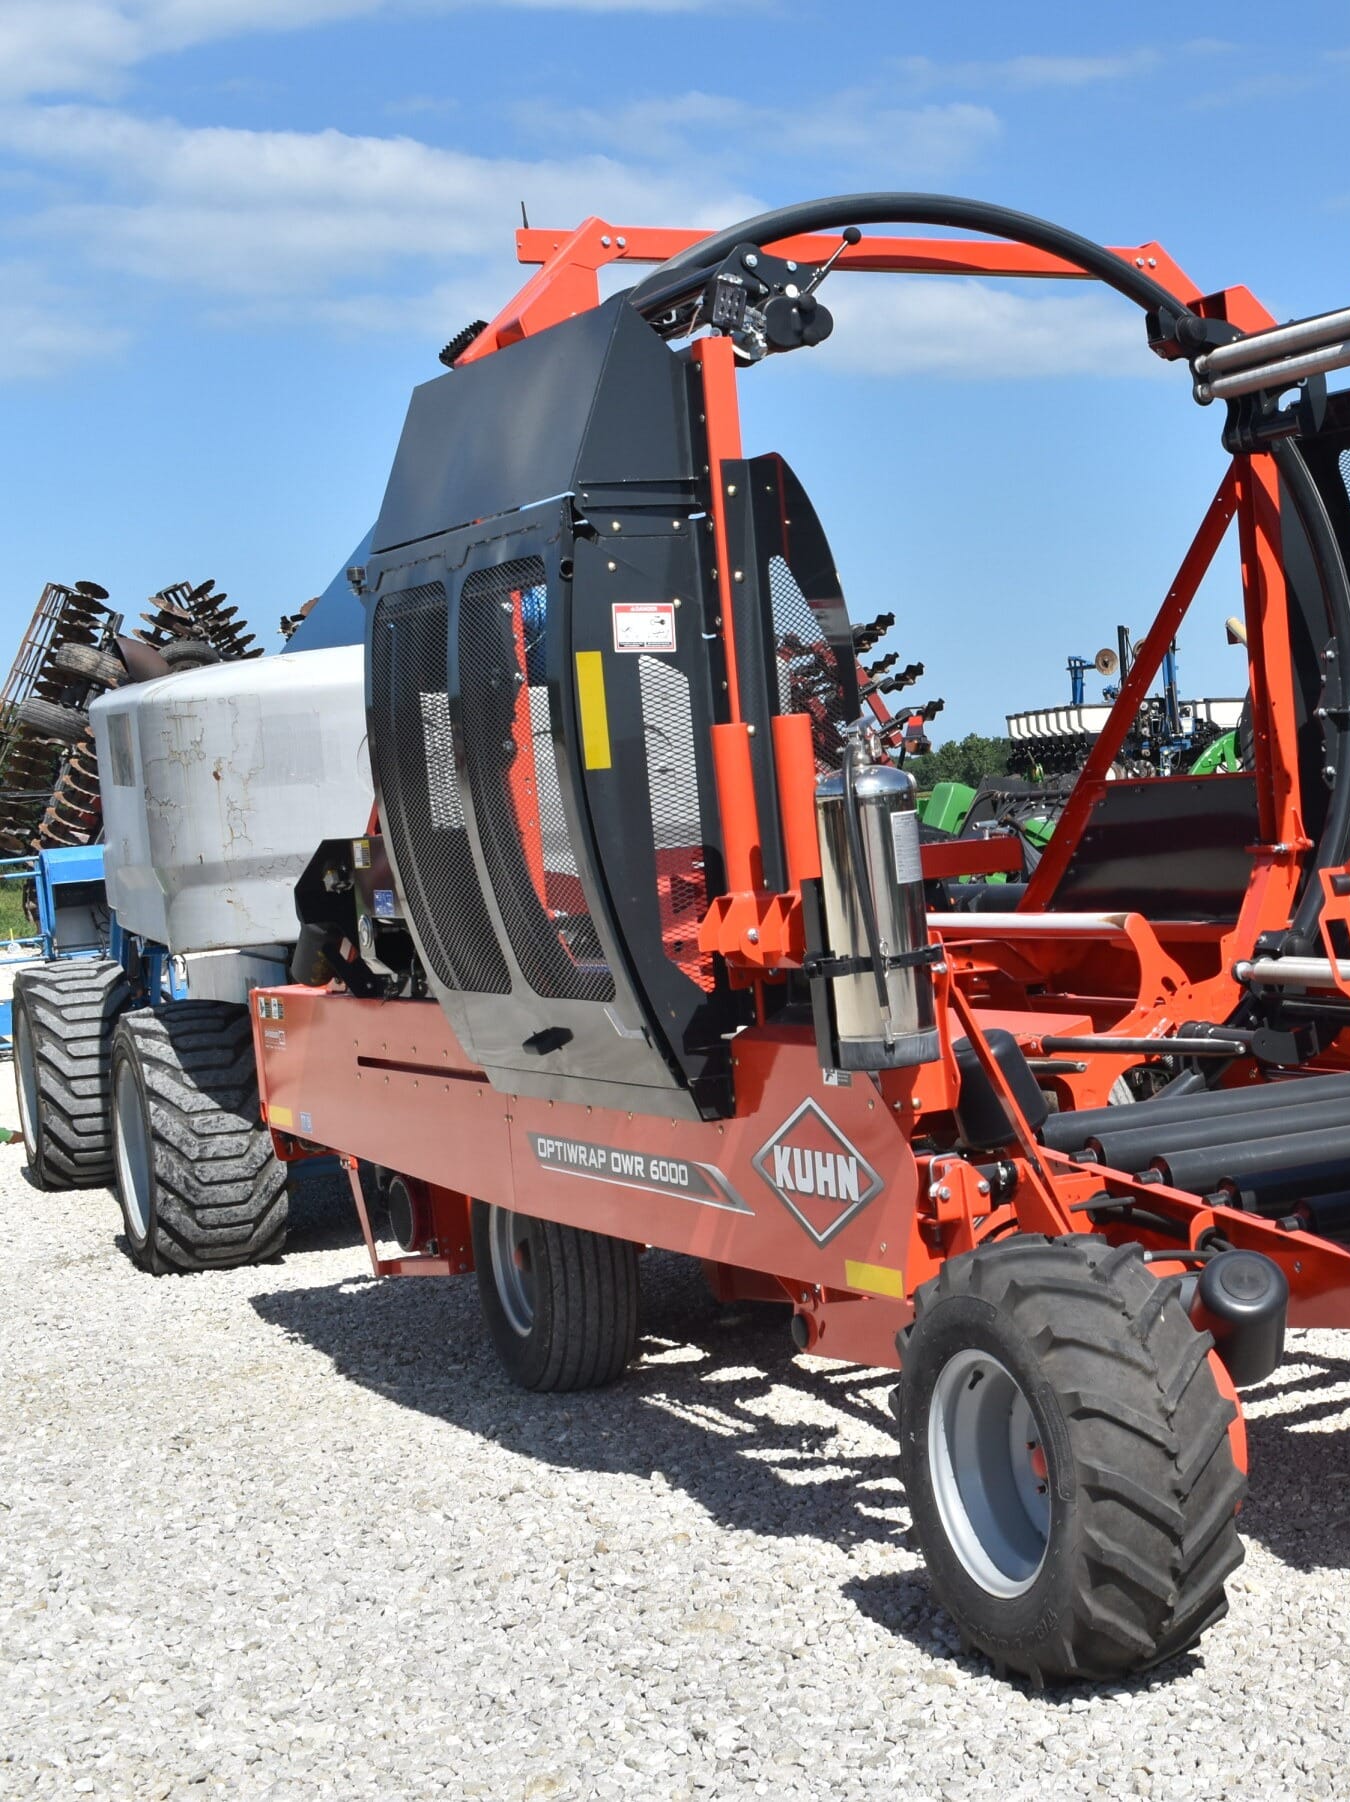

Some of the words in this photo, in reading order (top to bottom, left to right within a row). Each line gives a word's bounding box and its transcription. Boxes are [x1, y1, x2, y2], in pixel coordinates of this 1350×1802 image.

[537, 1137, 607, 1169] OPTIWRAP
[611, 1152, 646, 1178] OWR
[650, 1159, 689, 1186] 6000
[773, 1144, 860, 1202] KUHN
